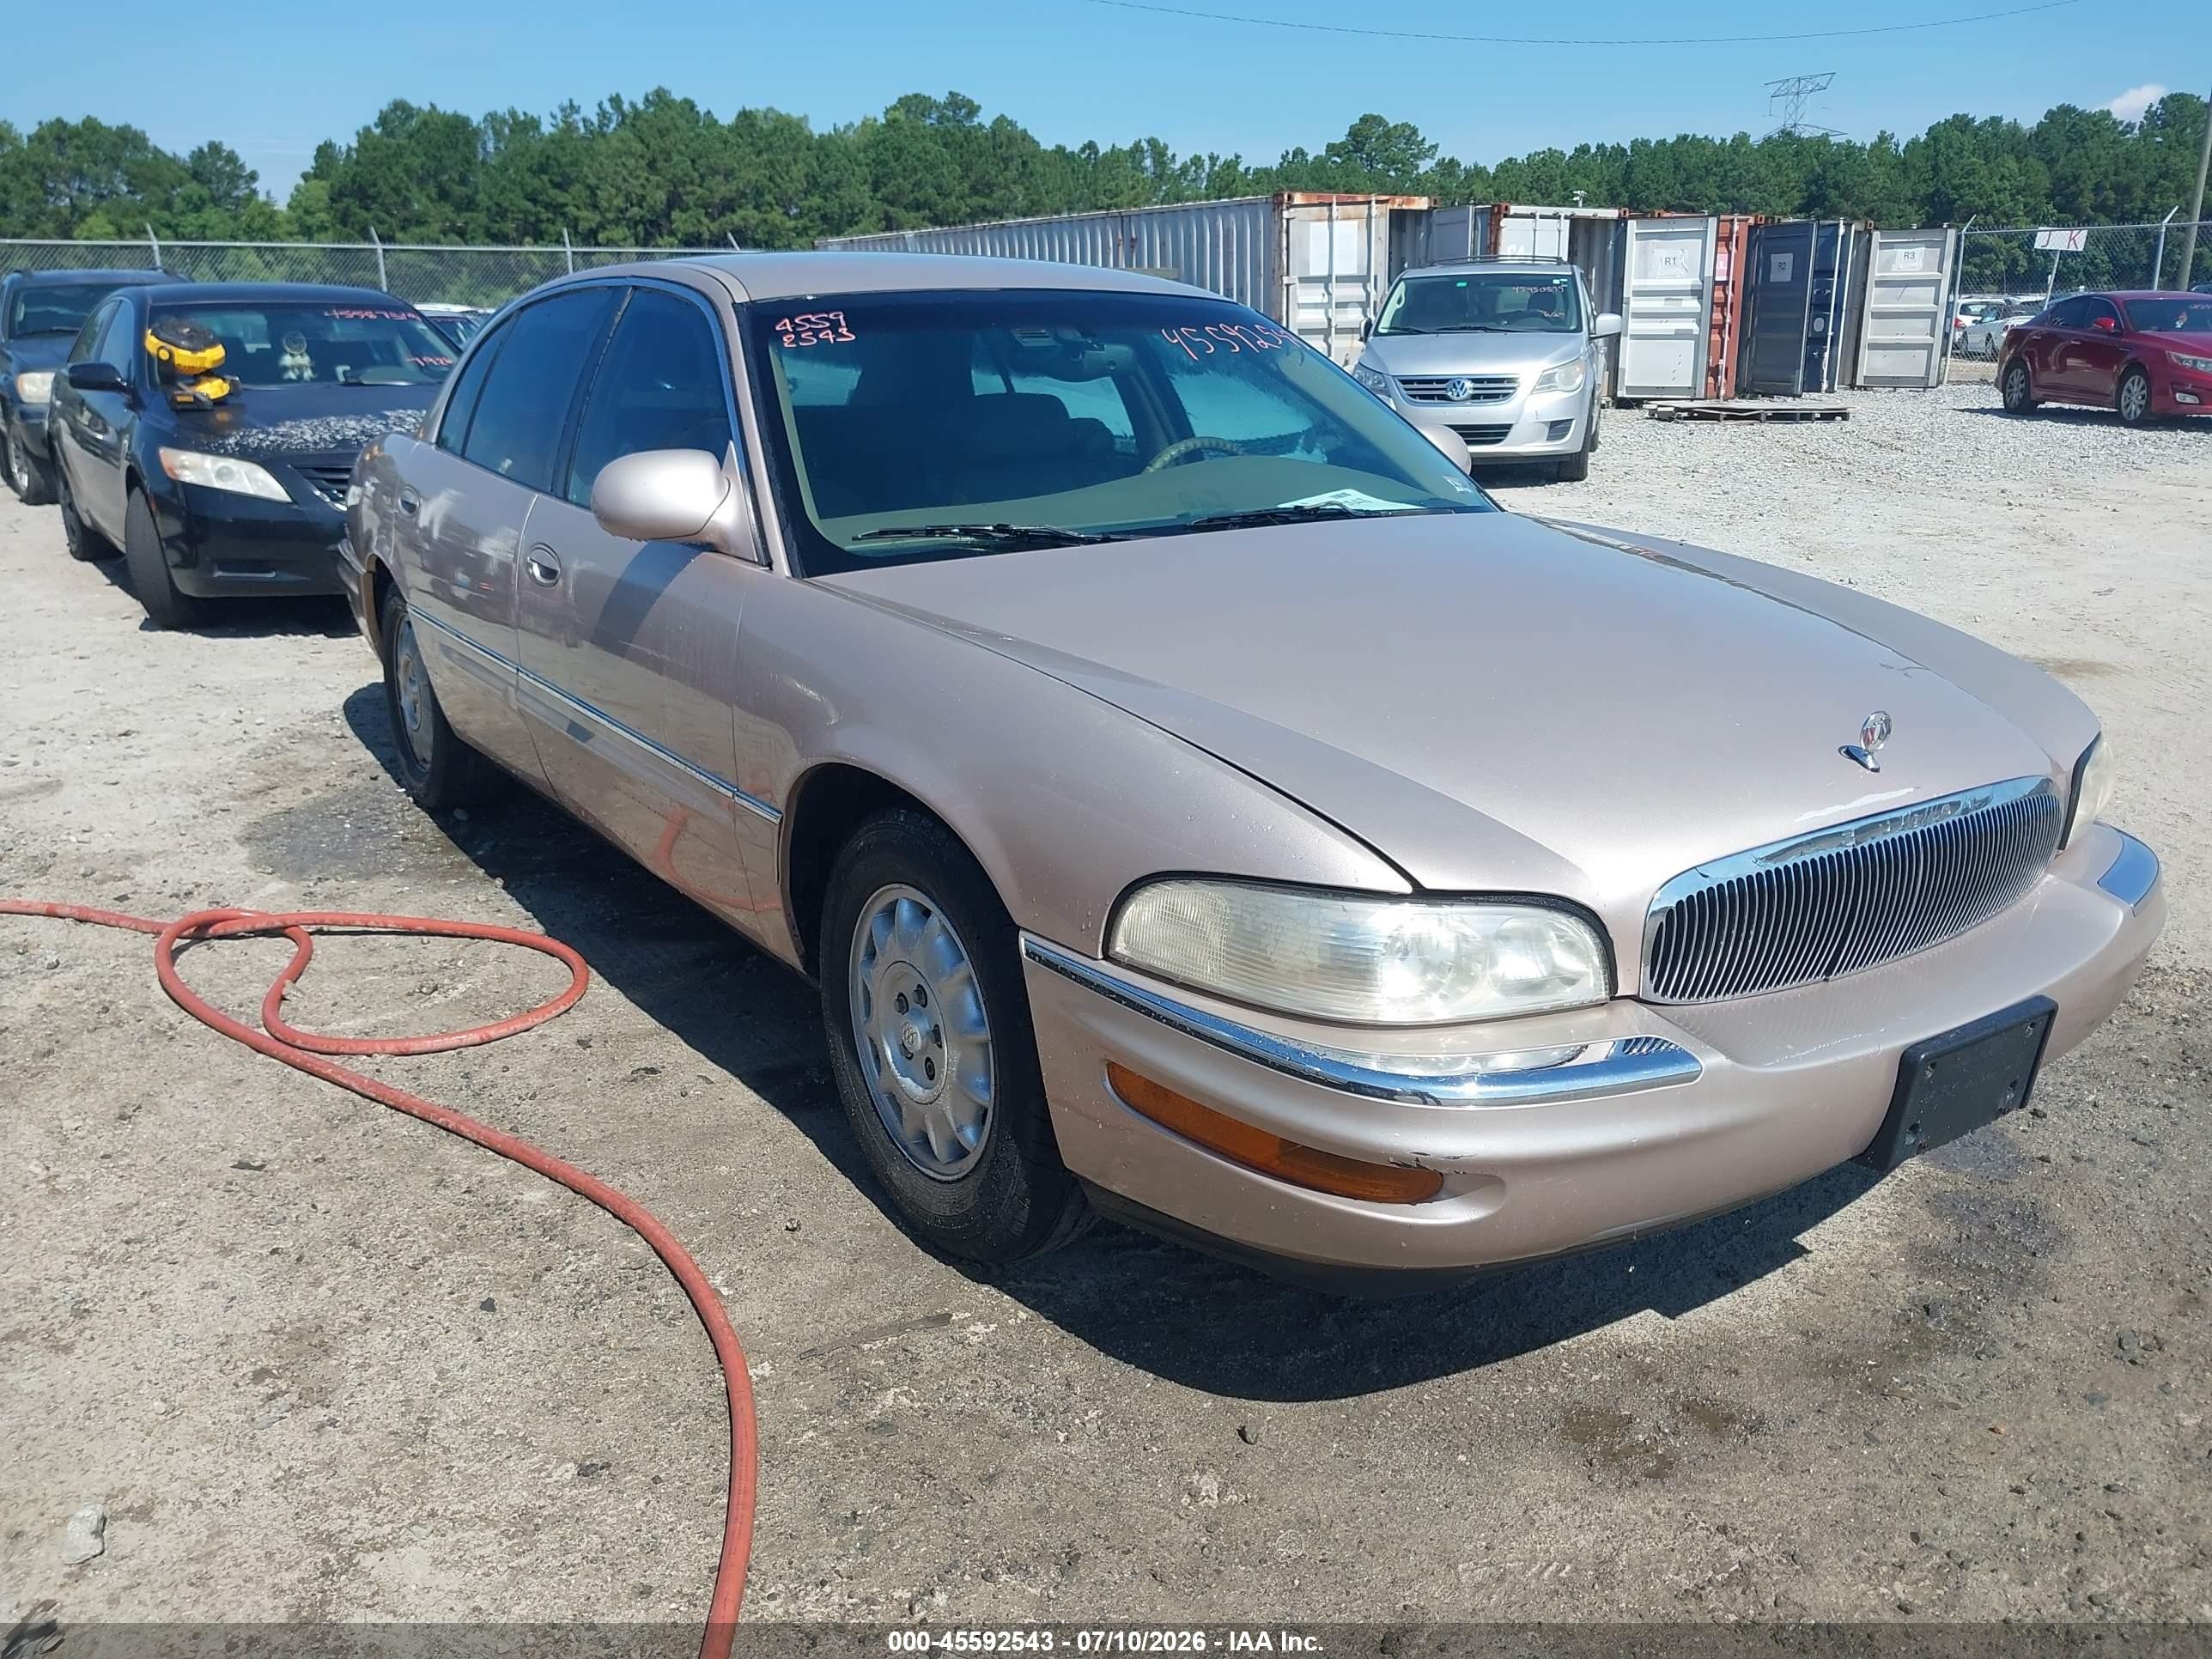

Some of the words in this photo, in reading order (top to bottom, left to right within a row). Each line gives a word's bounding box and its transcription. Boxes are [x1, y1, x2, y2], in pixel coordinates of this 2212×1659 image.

[2041, 230, 2051, 247] J
[2067, 229, 2082, 249] K
[1664, 257, 1676, 265] R1
[775, 312, 845, 331] 4559
[782, 327, 856, 347] 2543
